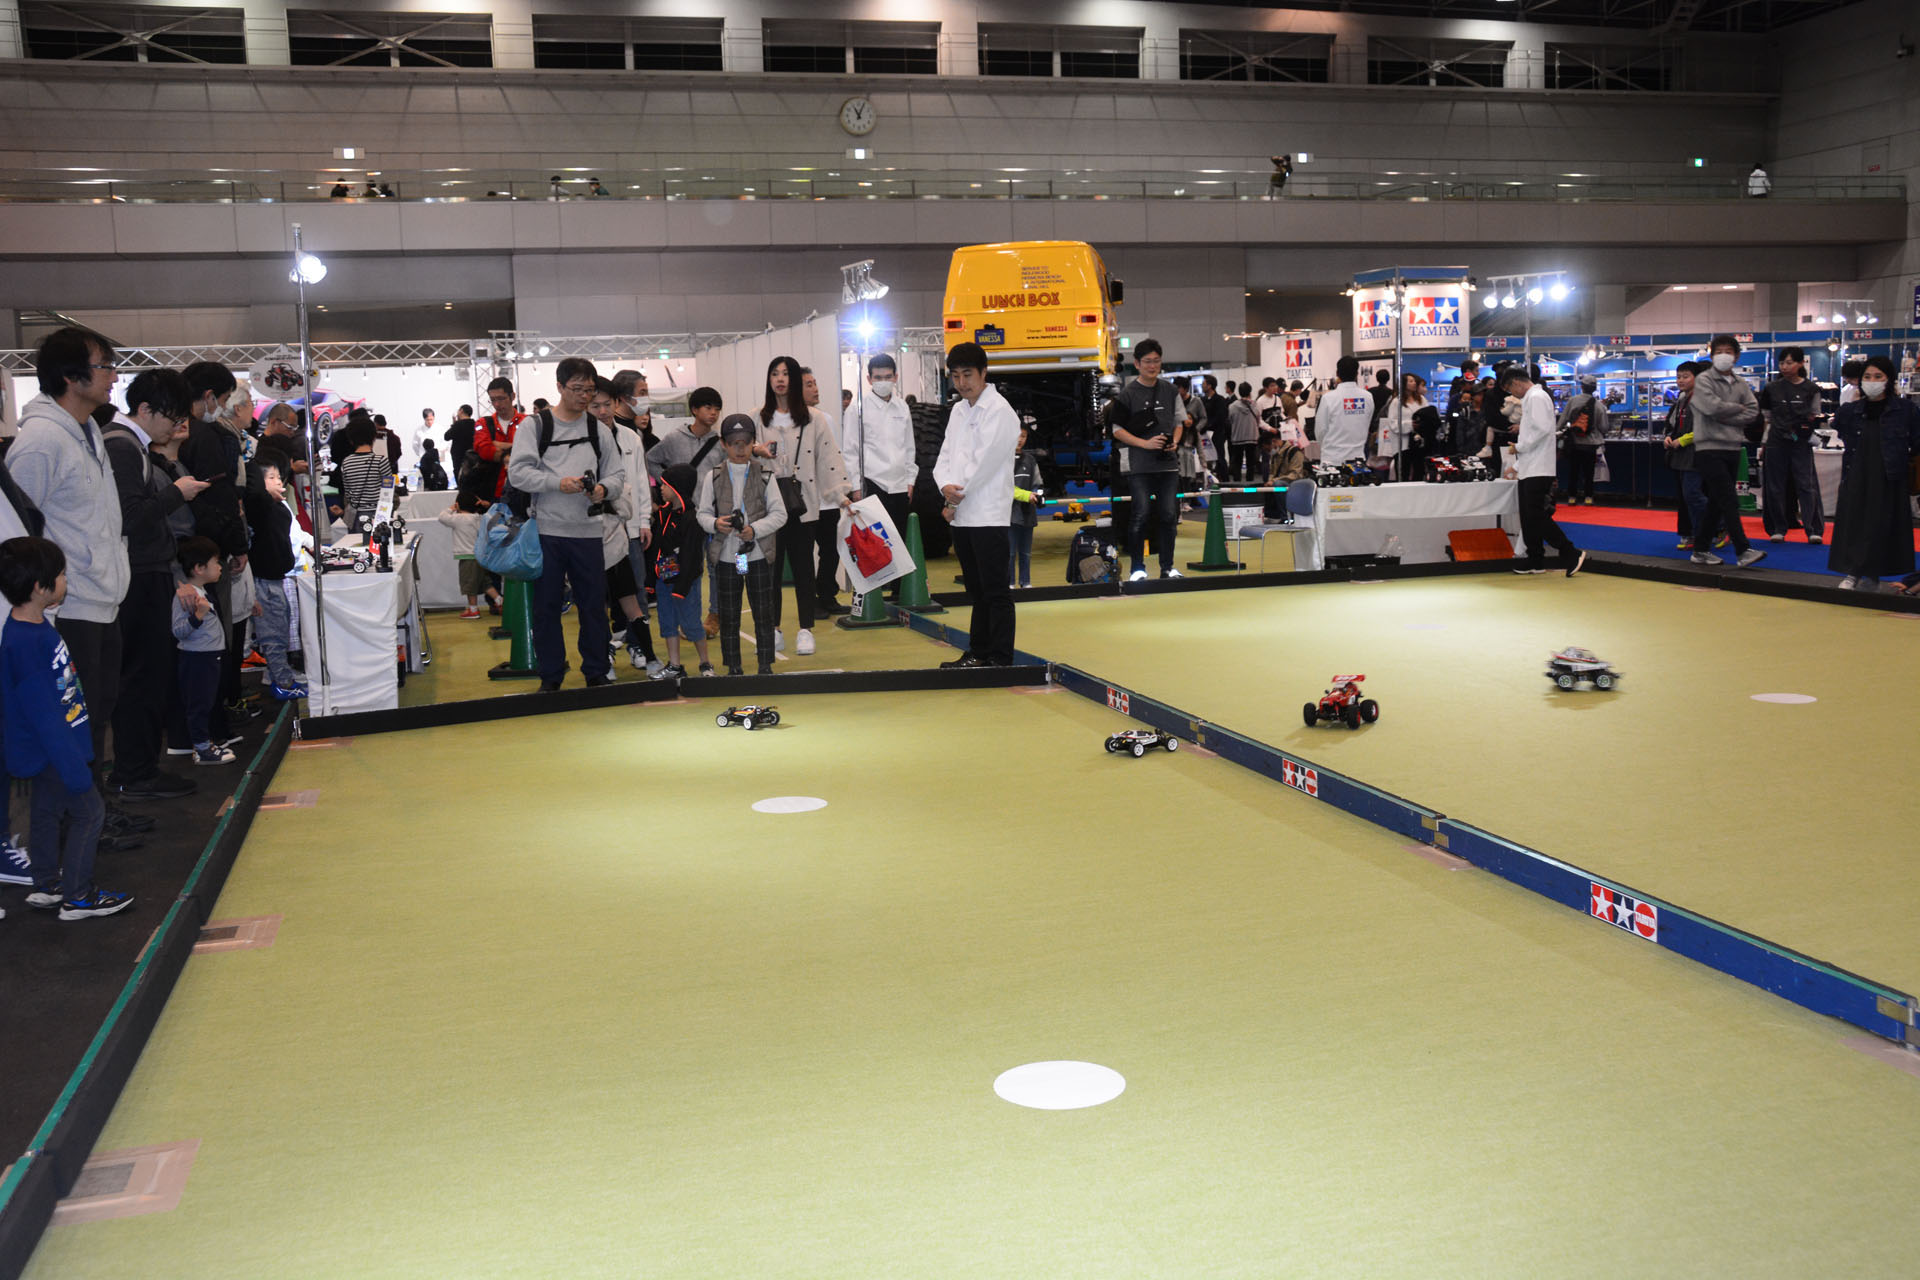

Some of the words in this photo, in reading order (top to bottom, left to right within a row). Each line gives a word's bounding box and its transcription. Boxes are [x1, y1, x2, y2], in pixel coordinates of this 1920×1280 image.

[982, 293, 1025, 309] LUNCH
[1028, 292, 1060, 307] BOX
[1360, 327, 1390, 341] TAMIYA
[1409, 325, 1460, 337] TAMIYA
[978, 335, 1001, 343] VANESSA
[1287, 369, 1312, 379] TAMIYA
